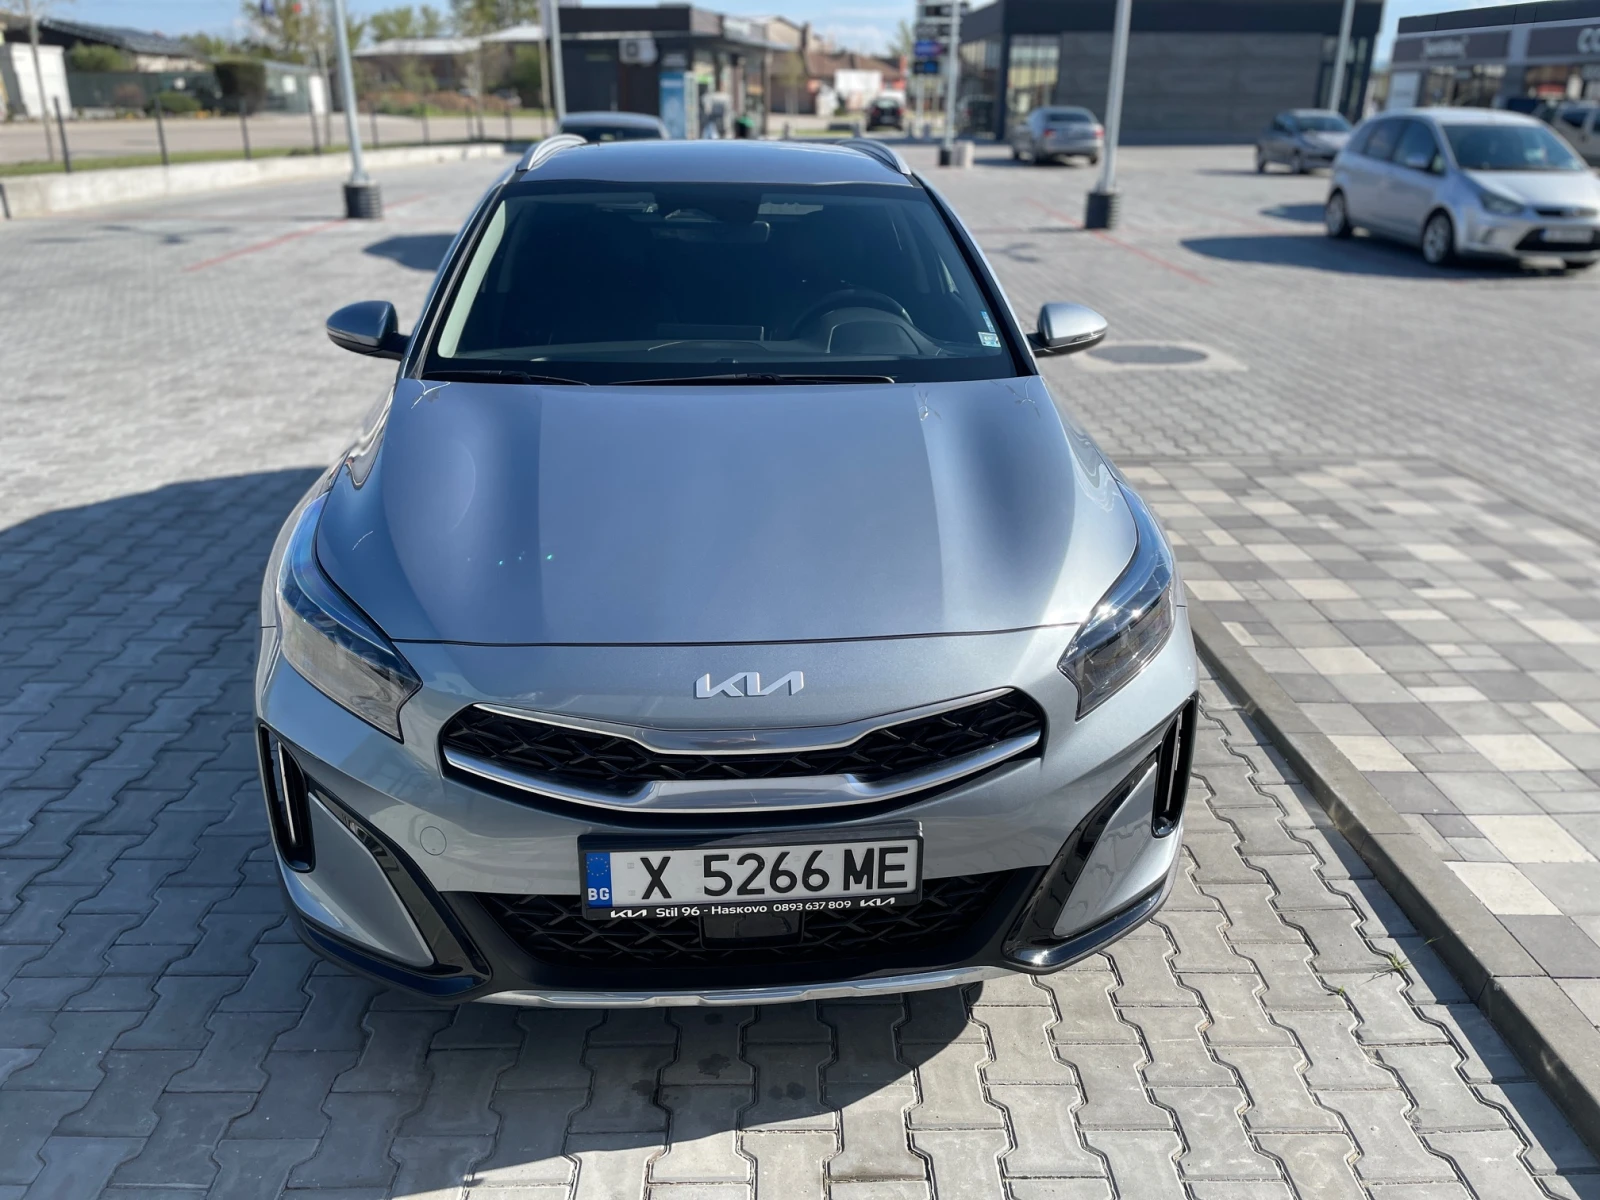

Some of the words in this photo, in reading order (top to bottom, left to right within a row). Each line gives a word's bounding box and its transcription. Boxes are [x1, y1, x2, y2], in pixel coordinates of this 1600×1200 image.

[693, 670, 804, 699] KIA
[639, 855, 673, 901] X
[703, 849, 830, 897] 5266
[843, 846, 909, 892] ME
[587, 887, 610, 901] BG
[610, 908, 648, 918] KIA
[656, 907, 678, 918] Stil
[681, 905, 700, 917] 96
[711, 904, 768, 915] Haskovo
[773, 902, 803, 912] 0893
[805, 900, 825, 911] 637
[828, 900, 851, 909] 809
[859, 897, 896, 907] KIA
